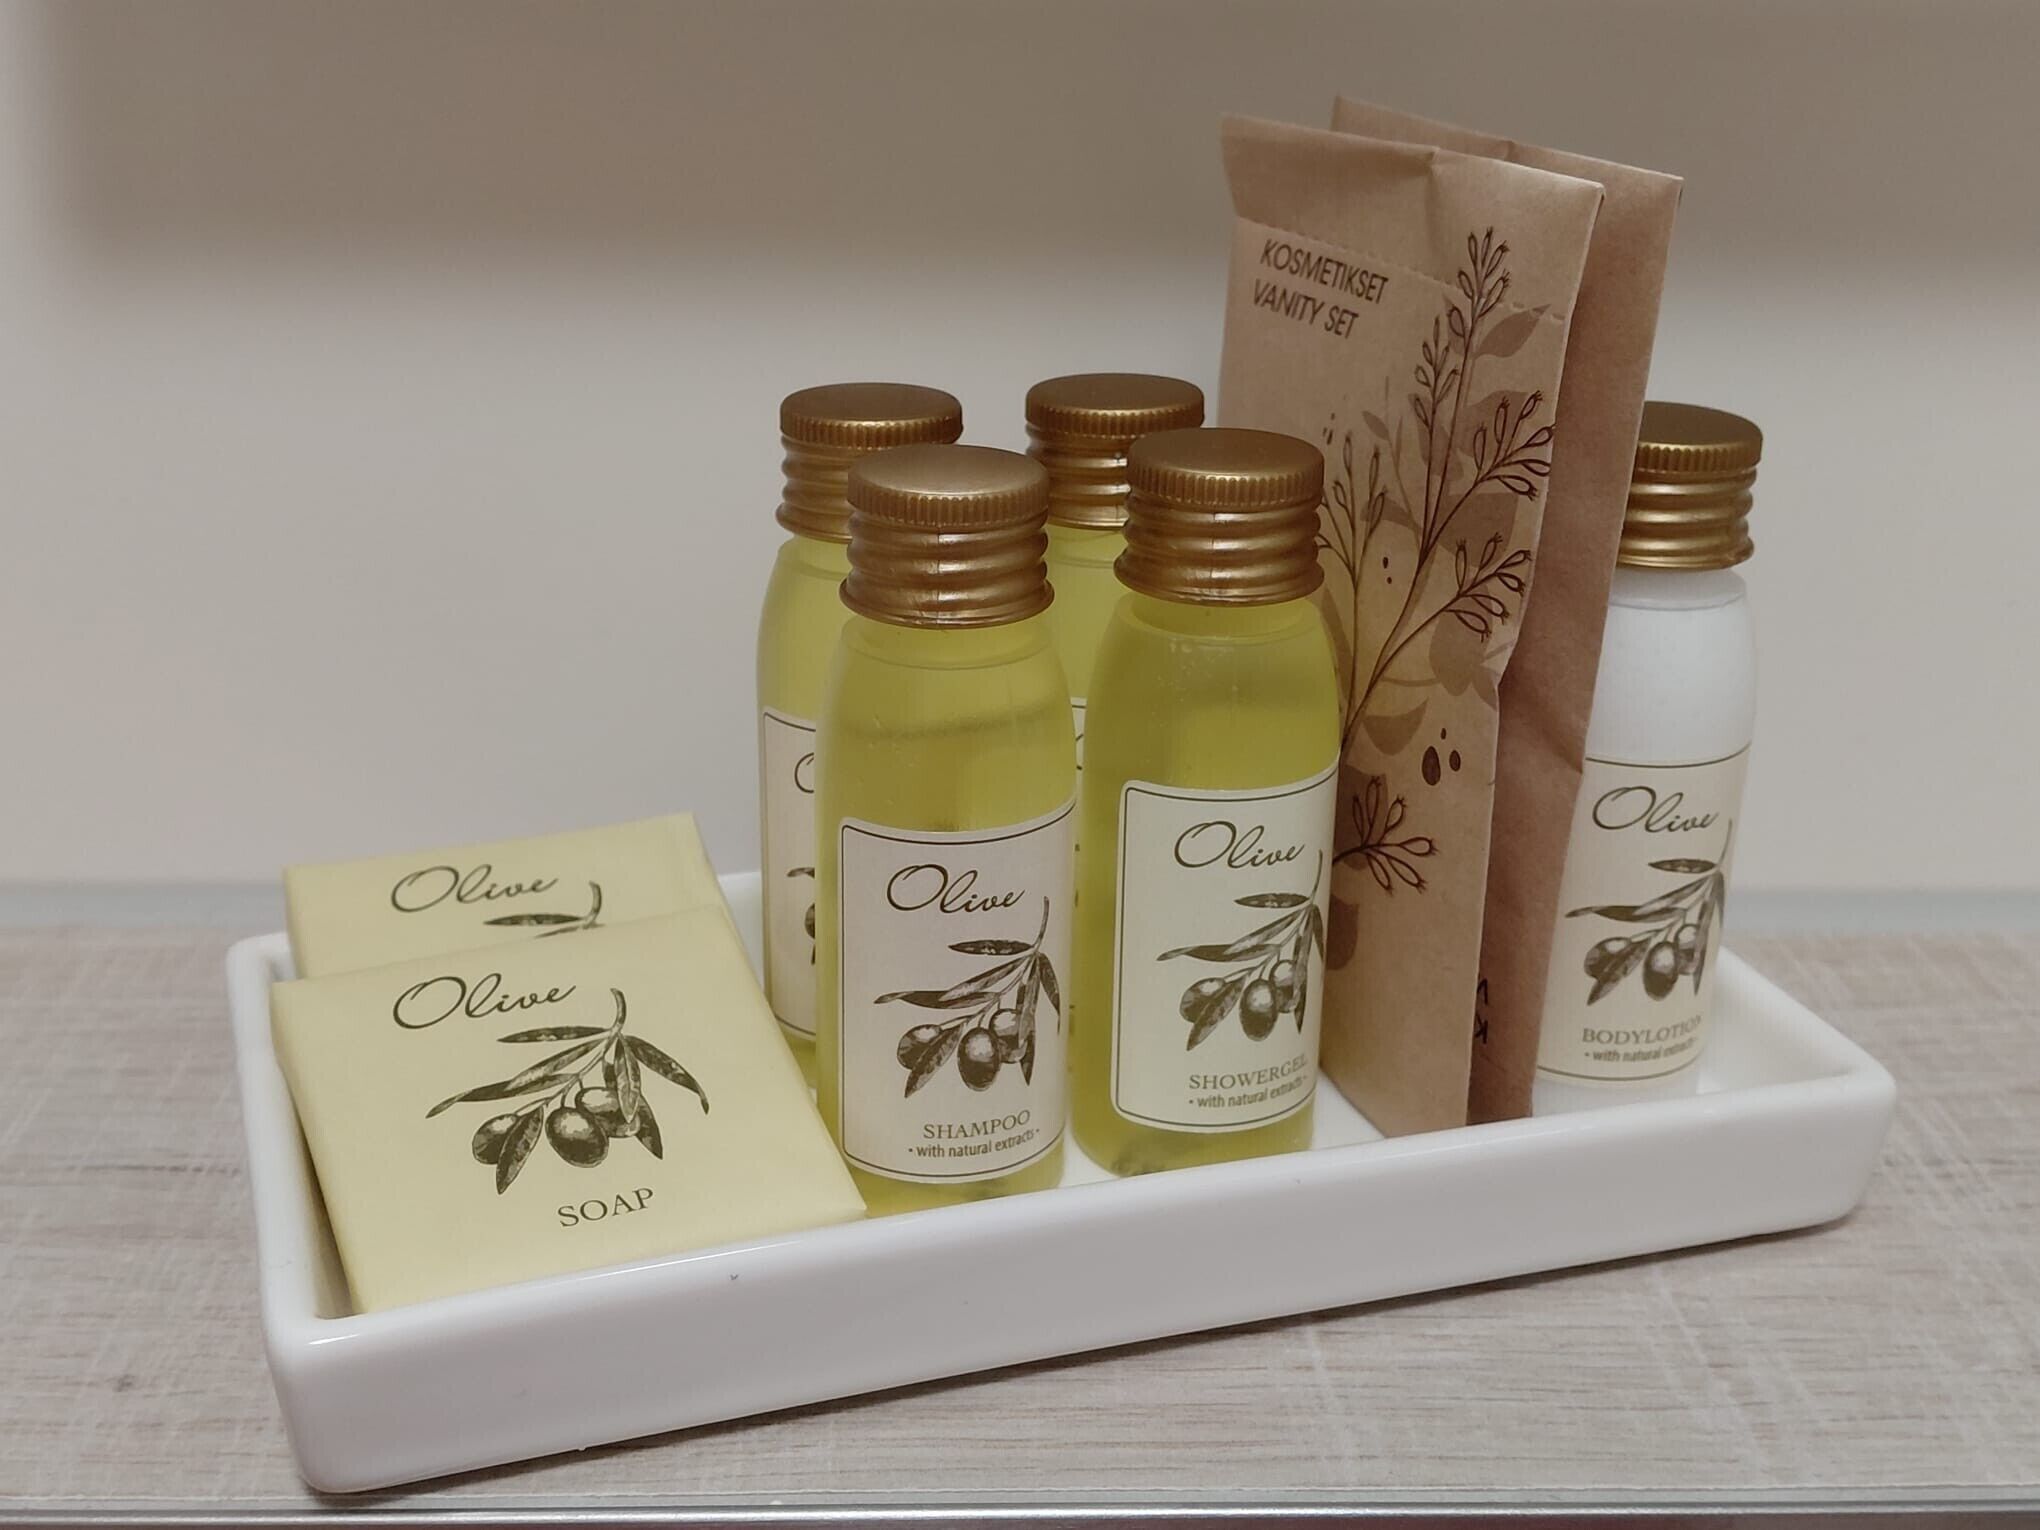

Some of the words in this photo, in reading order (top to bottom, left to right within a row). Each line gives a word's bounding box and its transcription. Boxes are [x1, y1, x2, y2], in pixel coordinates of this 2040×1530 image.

[1260, 239, 1390, 304] KOSMETIKSET
[1253, 278, 1326, 325] VANITY
[1324, 304, 1360, 339] SET
[1592, 786, 1719, 833] Olive
[1174, 821, 1305, 869] Olive
[391, 864, 558, 913] Olive
[886, 864, 1025, 914] Olive
[392, 973, 577, 1029] Olive
[1188, 1054, 1308, 1090] SHOWERGEL
[1197, 1094, 1226, 1109] with
[1228, 1088, 1268, 1108] natural
[916, 1144, 946, 1158] with
[948, 1140, 993, 1158] natural
[994, 1127, 1036, 1152] extracts
[922, 1109, 1032, 1140] SHAMPOO
[557, 1187, 655, 1228] SOAP
